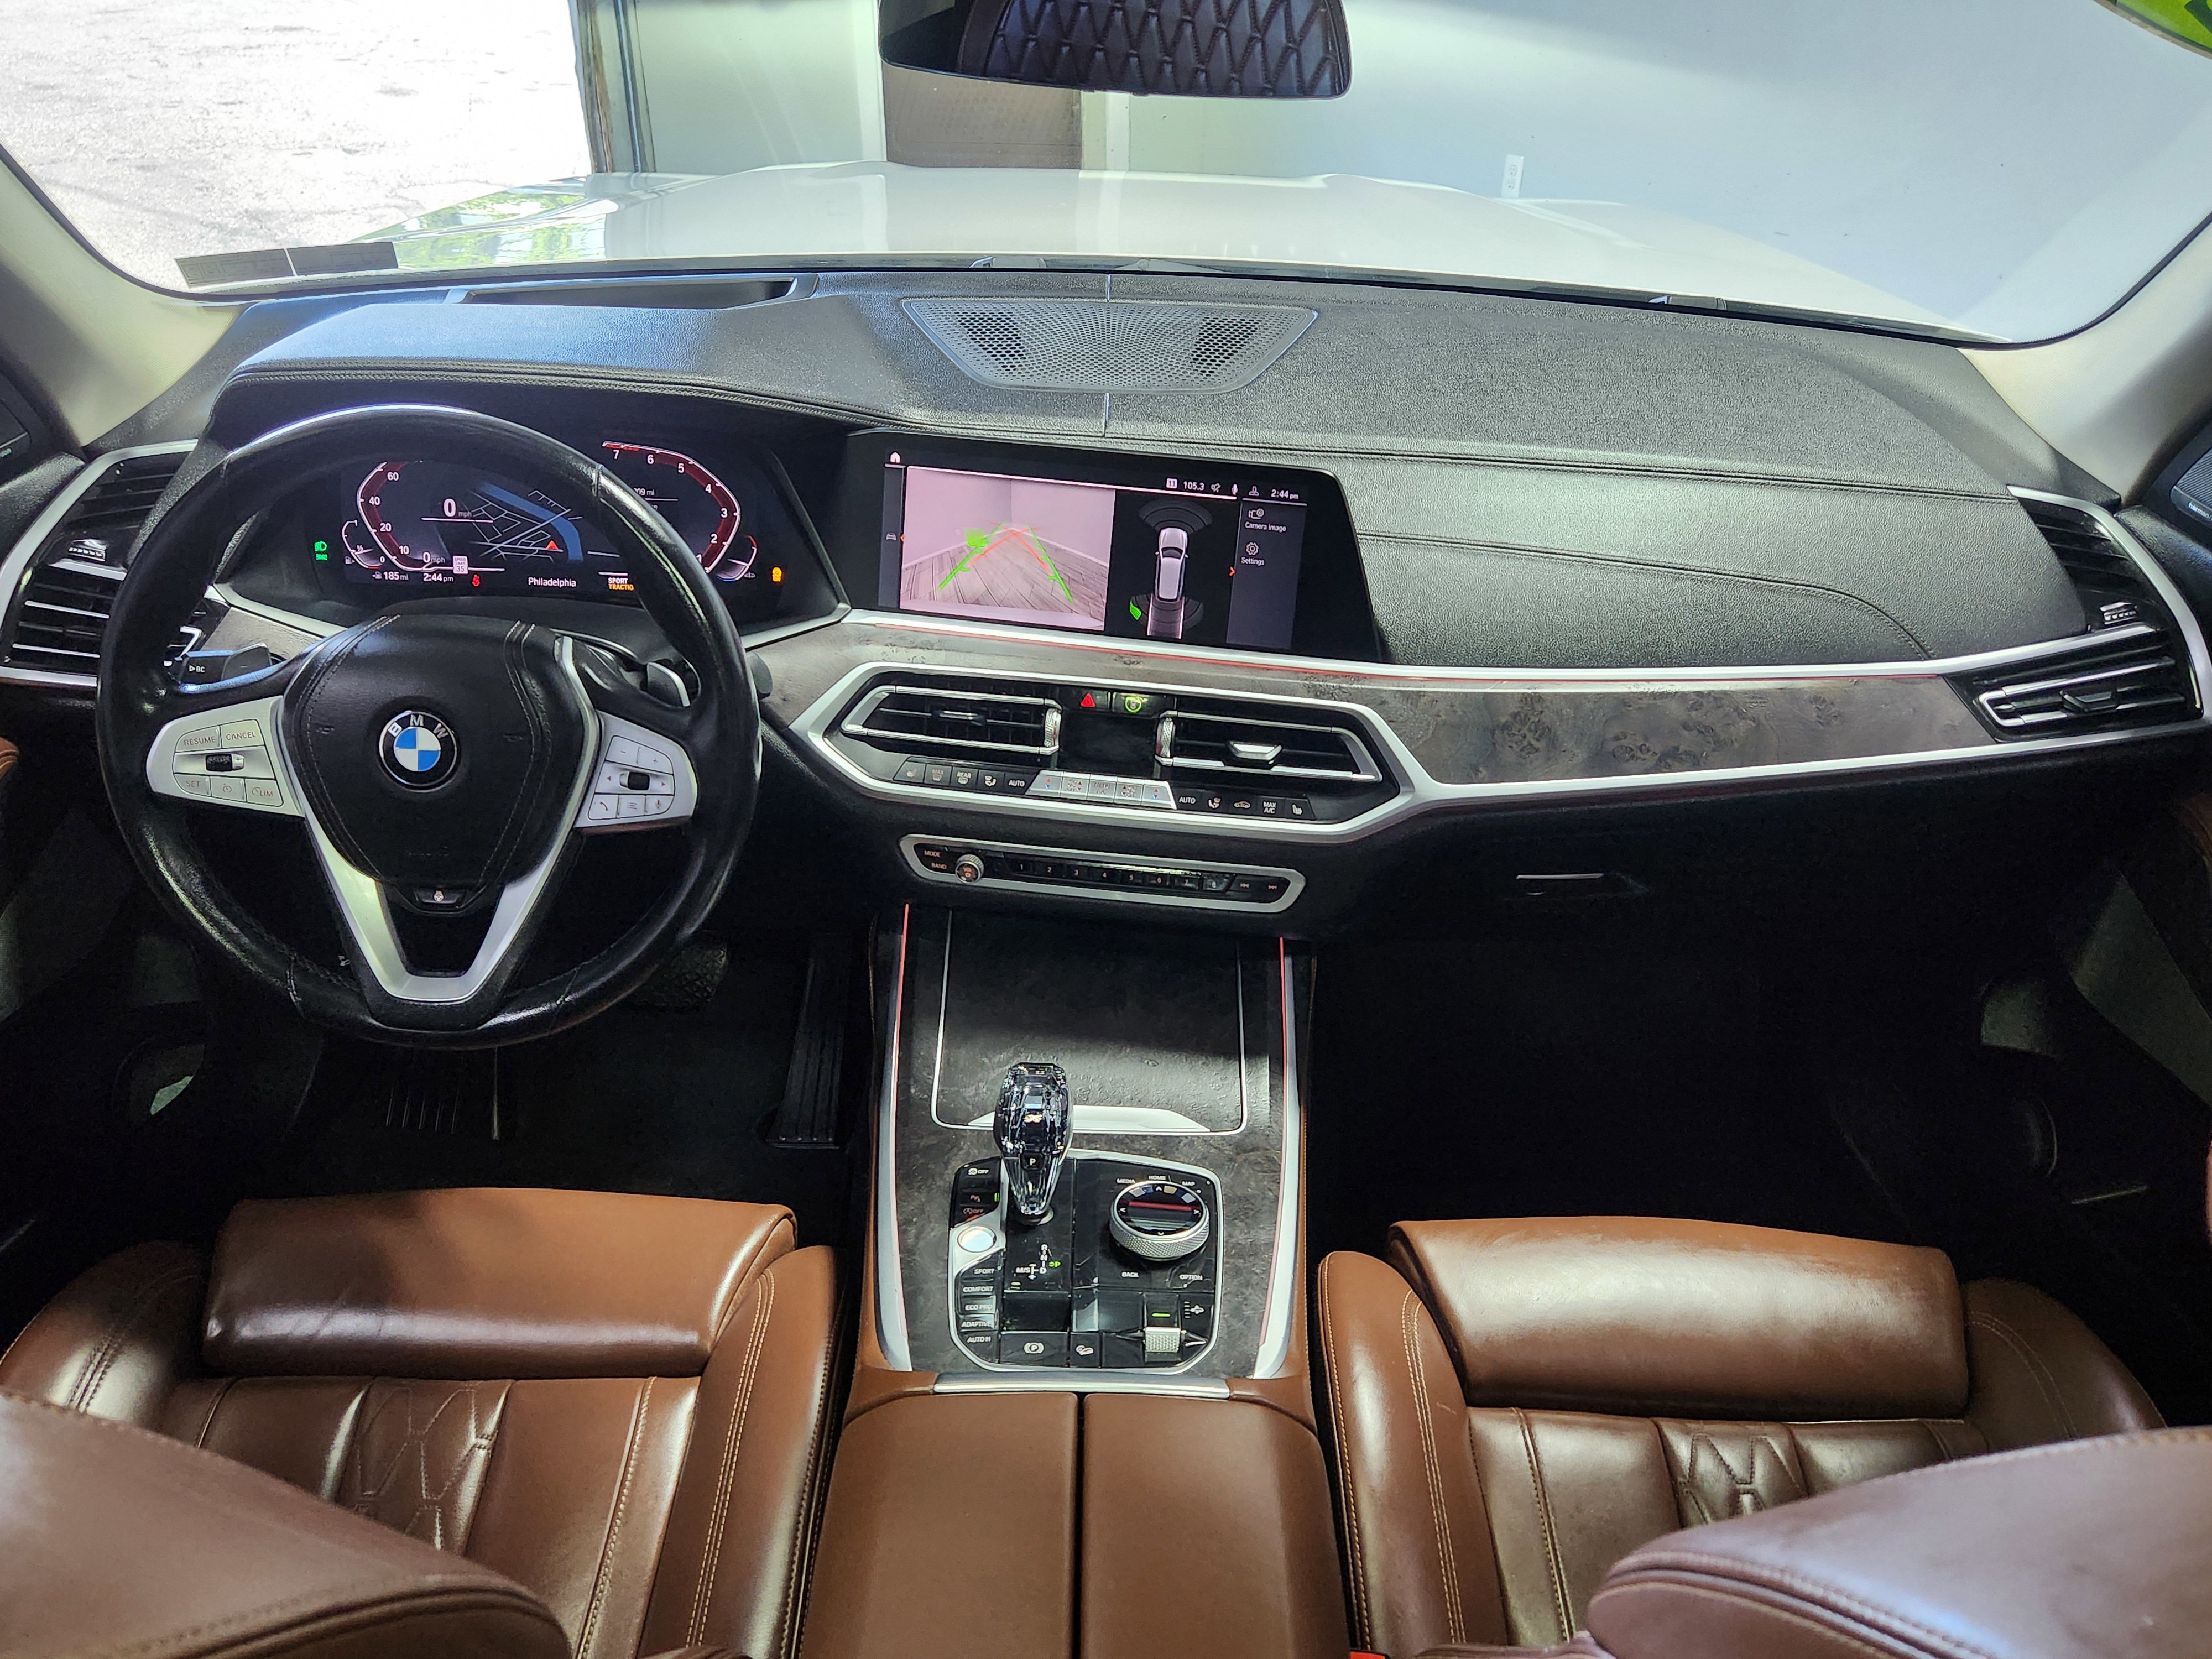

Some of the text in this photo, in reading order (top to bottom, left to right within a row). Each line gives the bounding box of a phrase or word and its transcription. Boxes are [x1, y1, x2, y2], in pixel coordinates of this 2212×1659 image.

[613, 450, 619, 460] 7
[647, 455, 654, 463] 6
[677, 463, 685, 473] 5
[387, 472, 399, 481] 60
[705, 484, 712, 493] 4
[1183, 481, 1204, 491] 105.3
[1271, 489, 1289, 498] 2:44
[369, 497, 380, 505] 40
[444, 498, 472, 518] 0 mph
[721, 508, 728, 518] 3
[380, 523, 392, 531] 20
[1245, 521, 1287, 533] Camera image
[711, 534, 717, 543] 2
[399, 545, 409, 554] 10
[423, 552, 430, 562] 0
[1241, 556, 1265, 566] Settings
[383, 571, 400, 580] 185
[423, 573, 442, 582] 2:44
[528, 577, 576, 588] Philadelphia
[388, 714, 450, 738] BMW
[226, 730, 257, 741] CANCEL
[183, 735, 216, 746] RESUME
[186, 780, 201, 789] SET
[1008, 779, 1025, 787] AUTO
[259, 789, 273, 797] LIM
[1178, 796, 1196, 804] AUTO
[1029, 1157, 1036, 1166] P
